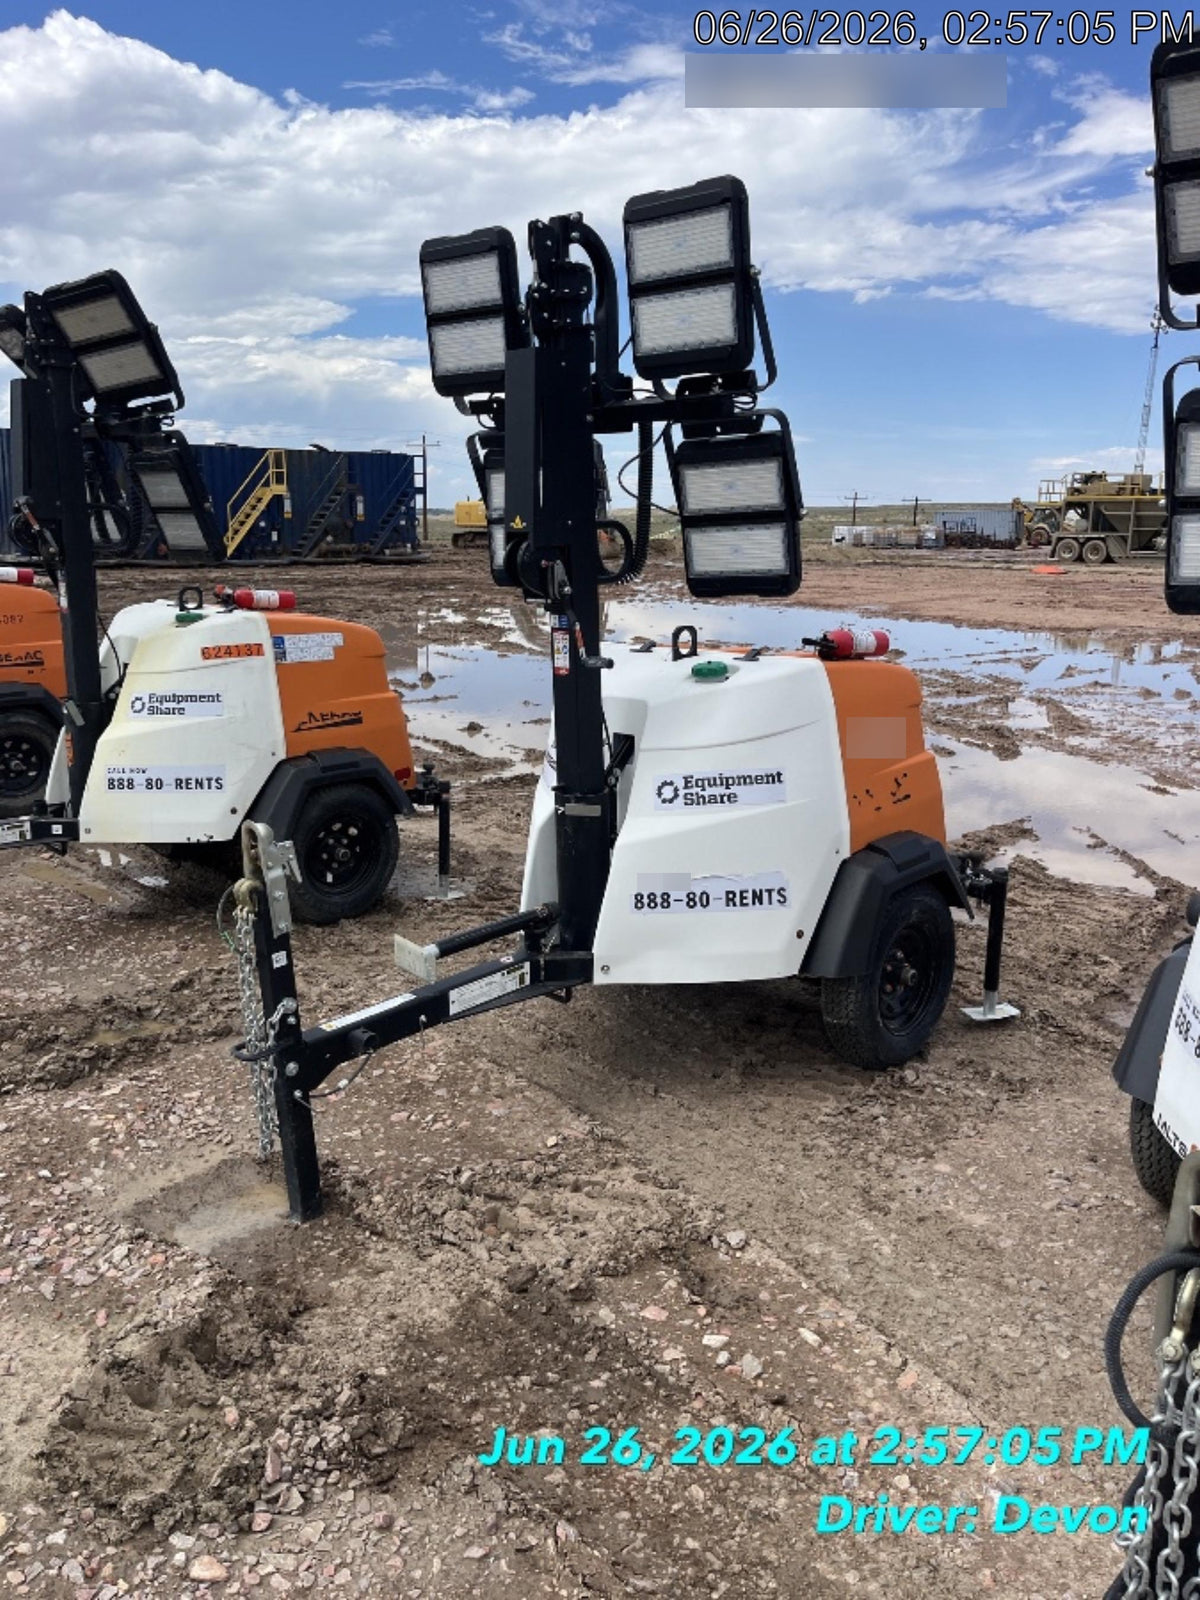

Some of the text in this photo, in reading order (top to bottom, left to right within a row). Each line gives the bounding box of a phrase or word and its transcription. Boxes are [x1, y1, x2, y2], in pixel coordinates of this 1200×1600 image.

[148, 693, 222, 706] Equipment
[147, 705, 186, 716] Share
[107, 776, 223, 790] 888-80-RENTS
[682, 771, 783, 791] Equipment
[683, 792, 738, 806] Share
[634, 886, 787, 910] 888-80-RENTS
